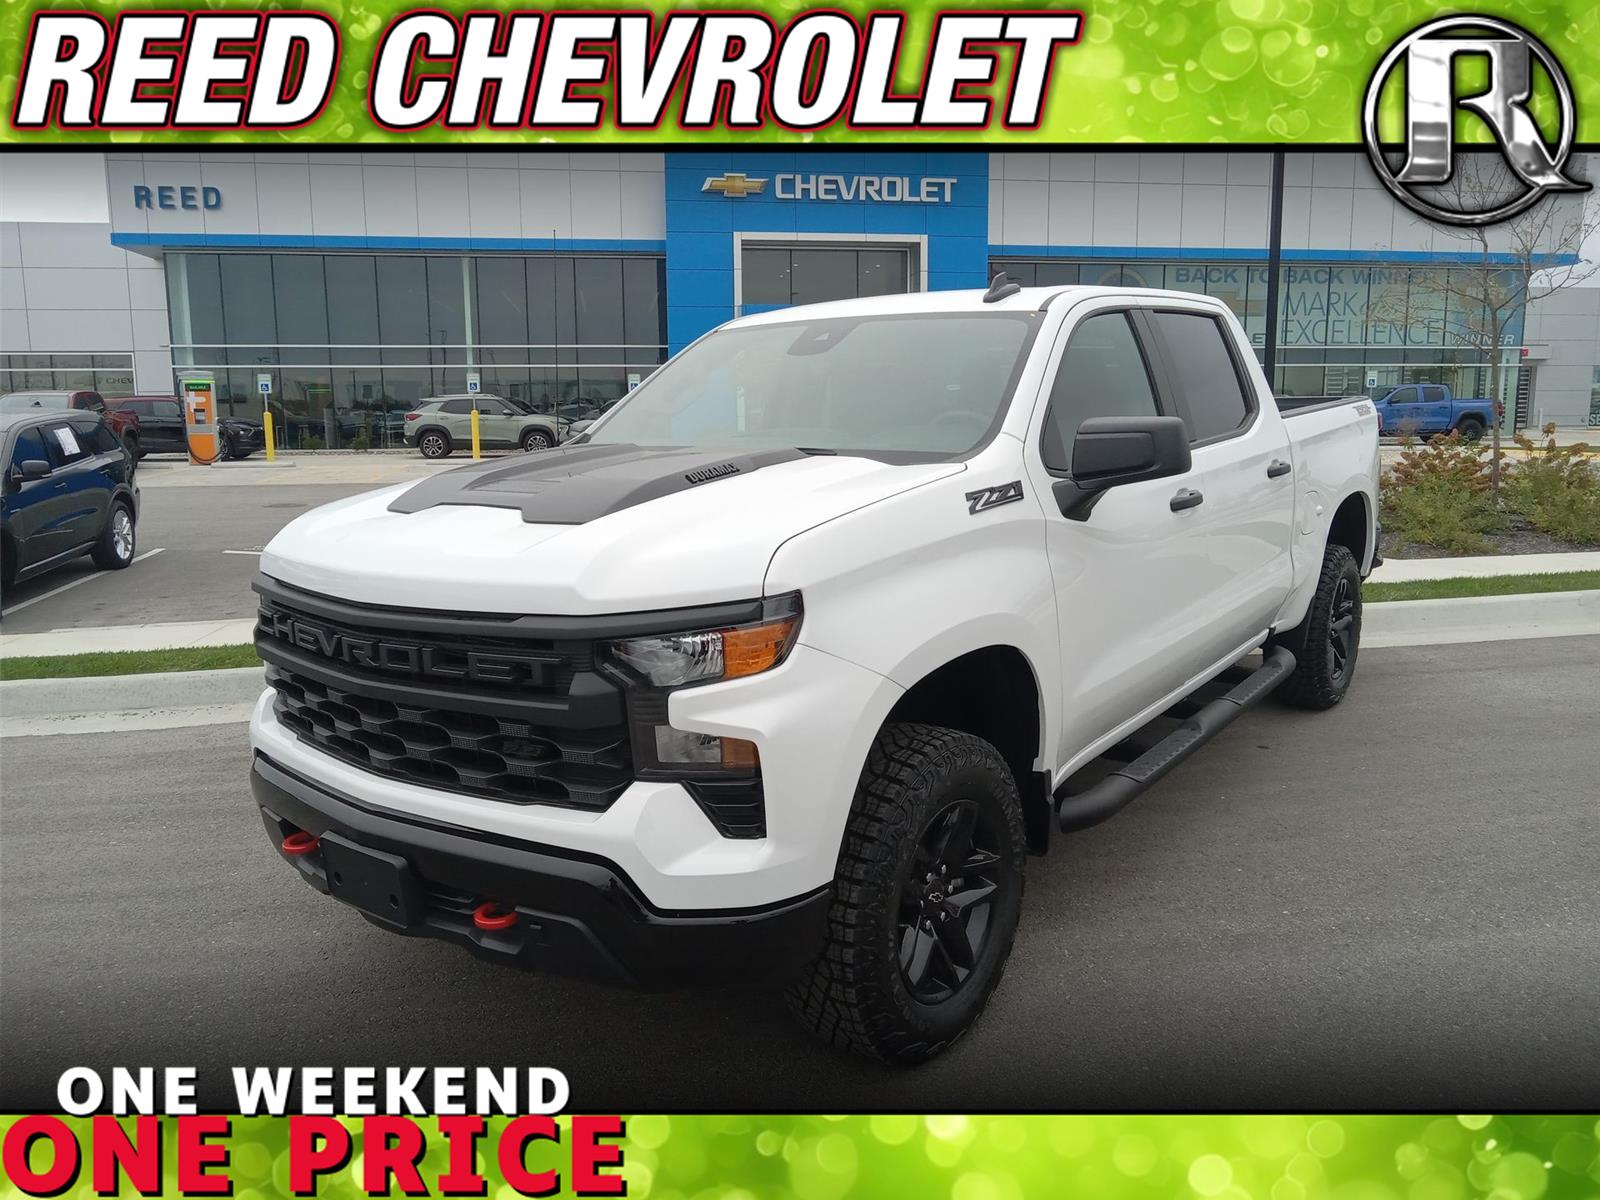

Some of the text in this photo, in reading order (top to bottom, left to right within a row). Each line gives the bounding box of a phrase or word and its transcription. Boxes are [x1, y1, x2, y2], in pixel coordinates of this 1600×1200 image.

[133, 185, 222, 209] REED
[775, 173, 957, 203] CHEVROLET
[1175, 267, 1239, 283] BACK
[1284, 269, 1345, 284] BACK
[1282, 292, 1358, 316] MARK
[1281, 319, 1438, 345] EXCELLENCE
[965, 480, 1024, 515] Z71
[257, 604, 562, 684] CHEVROLET
